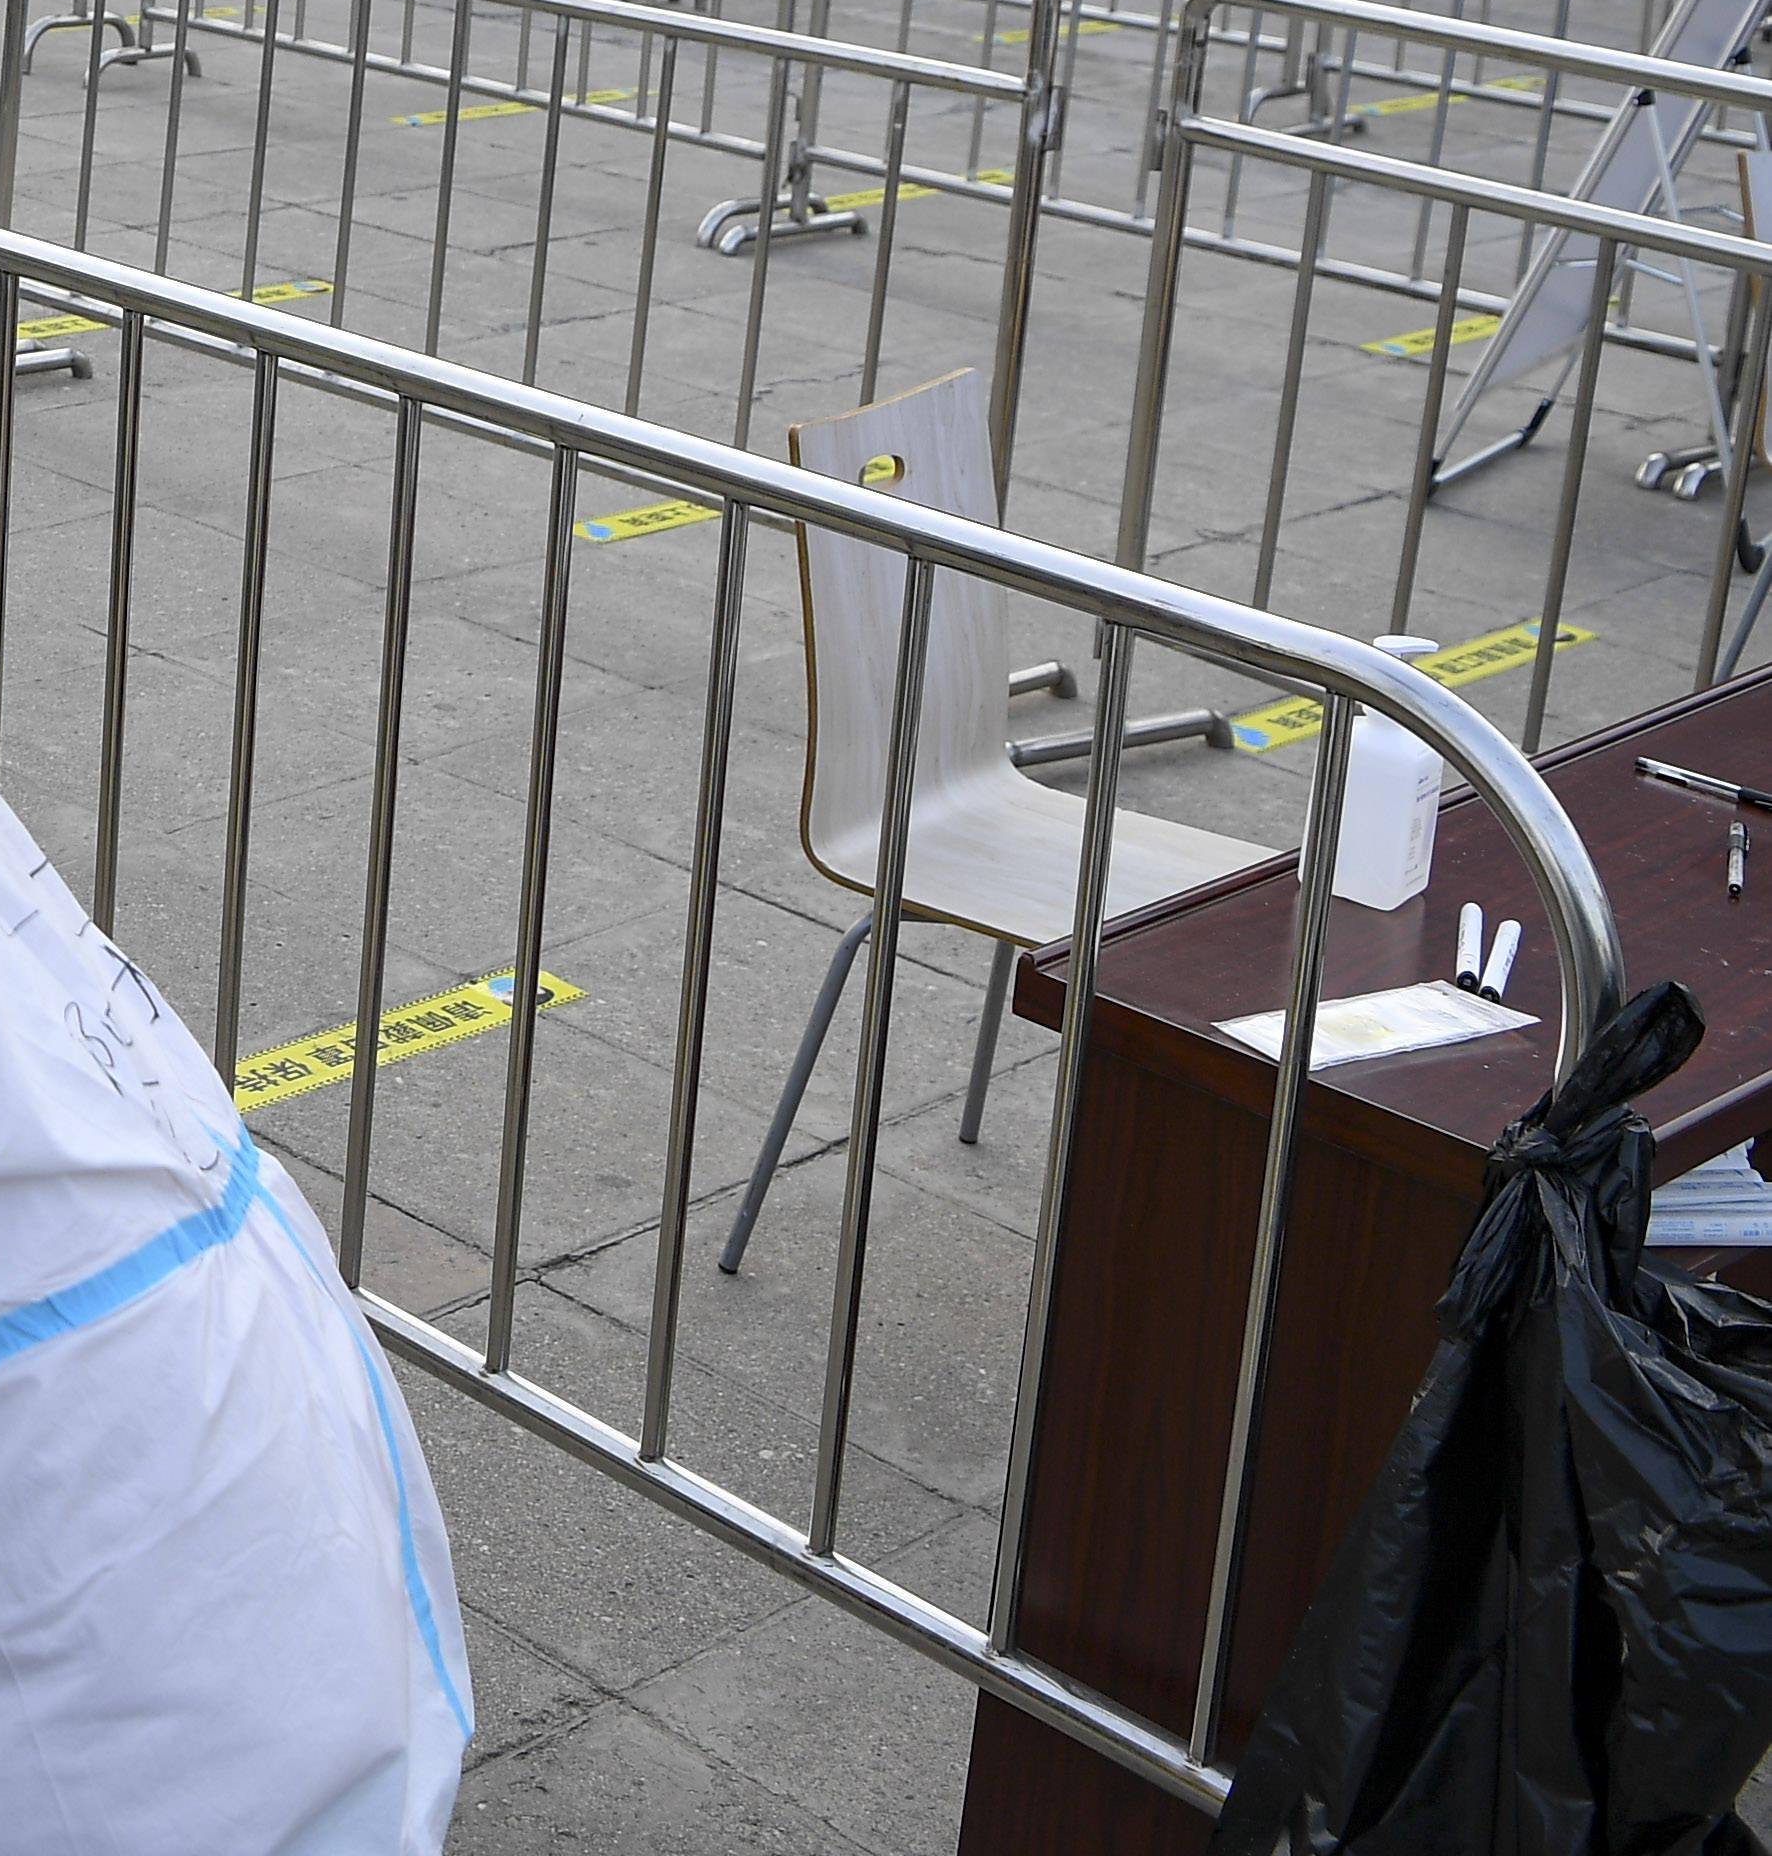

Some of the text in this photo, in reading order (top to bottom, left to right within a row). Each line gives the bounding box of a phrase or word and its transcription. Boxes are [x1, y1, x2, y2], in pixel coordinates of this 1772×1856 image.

[304, 1001, 493, 1069] 请佩戴口罩
